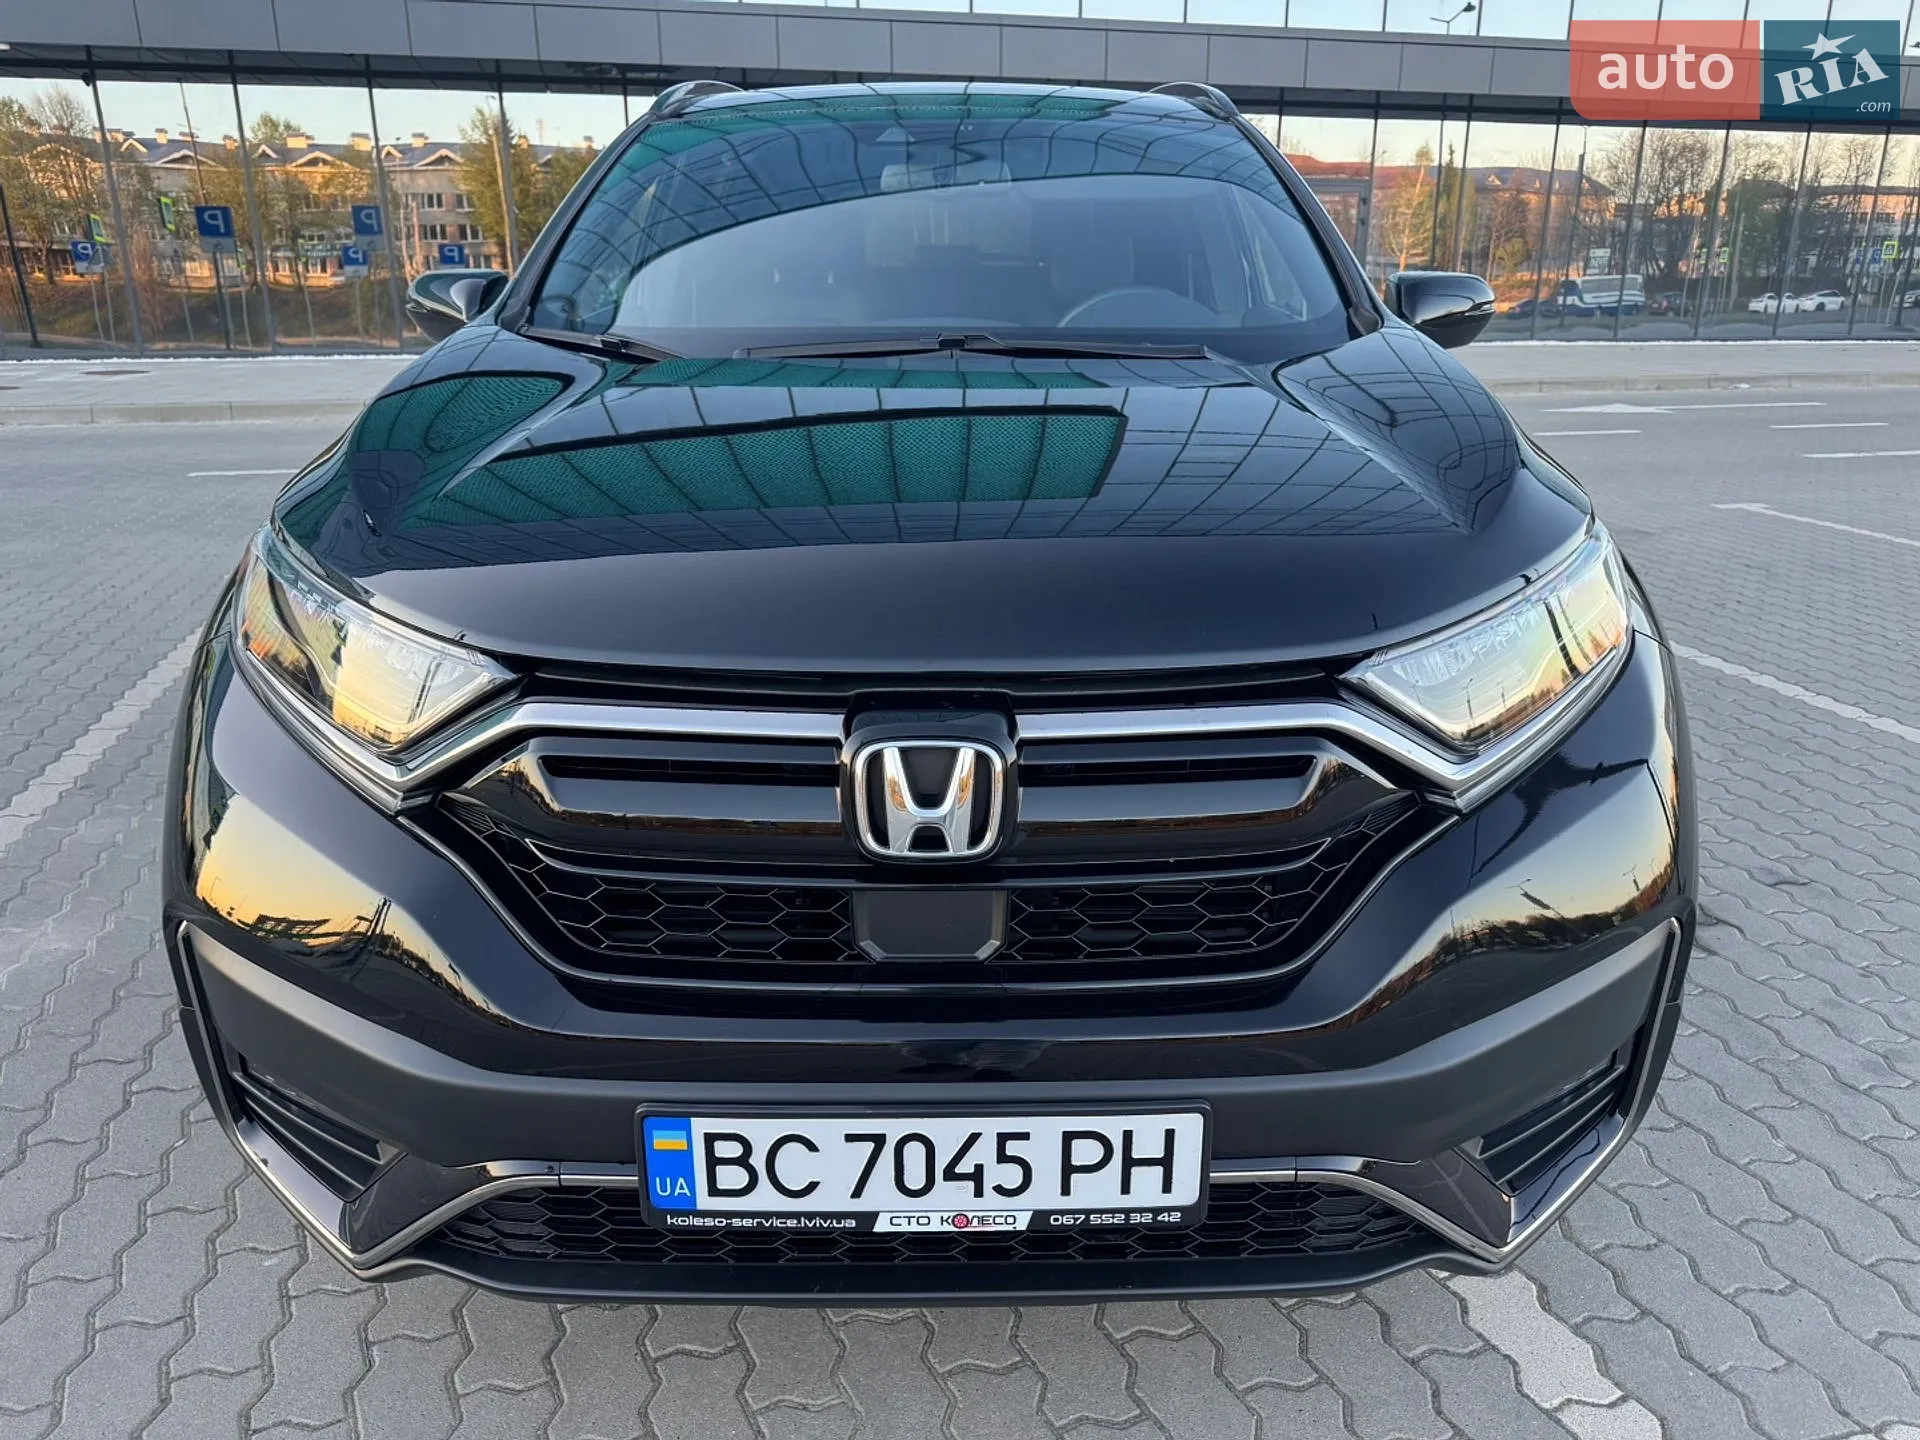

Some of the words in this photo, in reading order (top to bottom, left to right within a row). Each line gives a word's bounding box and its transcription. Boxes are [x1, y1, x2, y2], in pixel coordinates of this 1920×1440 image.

[705, 1131, 821, 1199] BC
[843, 1131, 1033, 1199] 7045
[1059, 1127, 1176, 1197] PH
[655, 1176, 691, 1198] UA
[666, 1214, 857, 1229] koleso-service.lviv.ua
[889, 1215, 931, 1227] СТО
[1050, 1214, 1086, 1226] 067
[1089, 1213, 1126, 1225] 552
[1129, 1212, 1153, 1224] 32
[1157, 1211, 1182, 1223] 42
